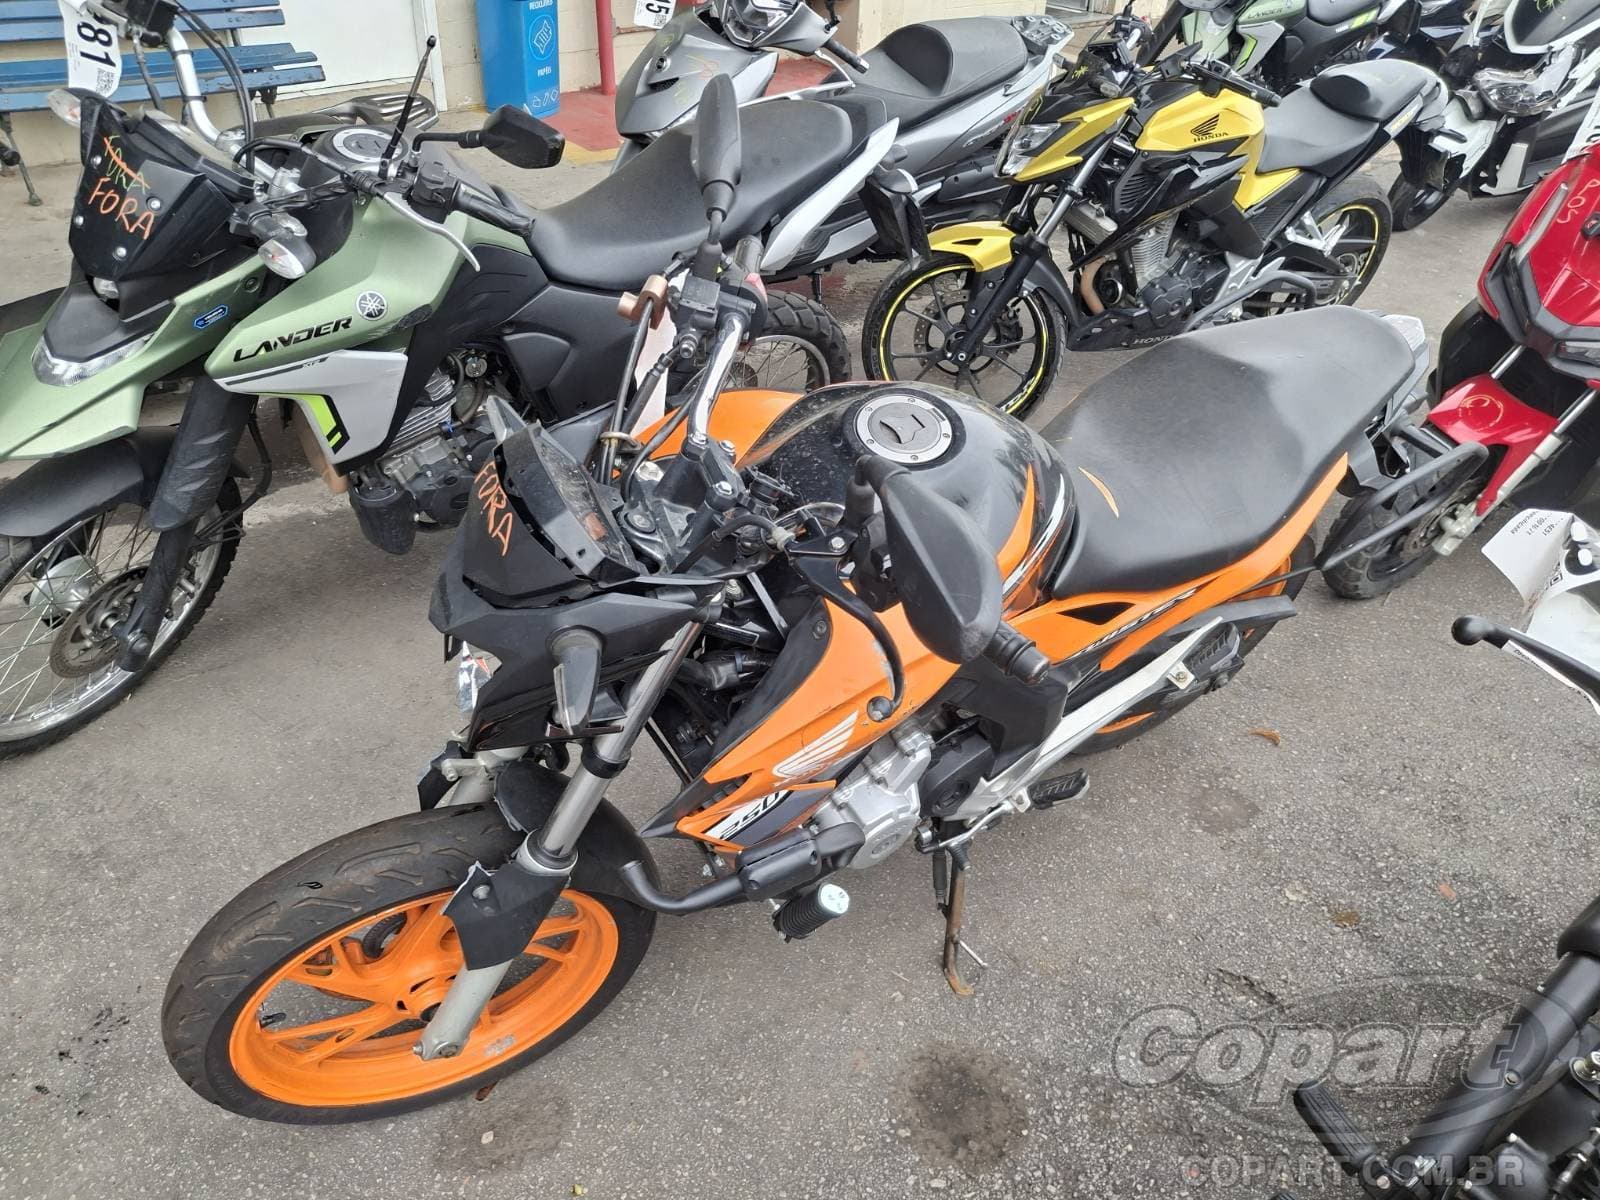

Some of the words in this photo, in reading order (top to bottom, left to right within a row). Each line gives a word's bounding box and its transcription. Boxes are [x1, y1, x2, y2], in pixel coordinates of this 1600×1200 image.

[76, 21, 117, 68] 81
[1193, 131, 1230, 143] HONDA
[88, 177, 156, 240] FORA
[233, 315, 353, 363] LANDER
[1133, 335, 1174, 345] HOND
[473, 460, 513, 557] FORA
[719, 791, 782, 840] 250
